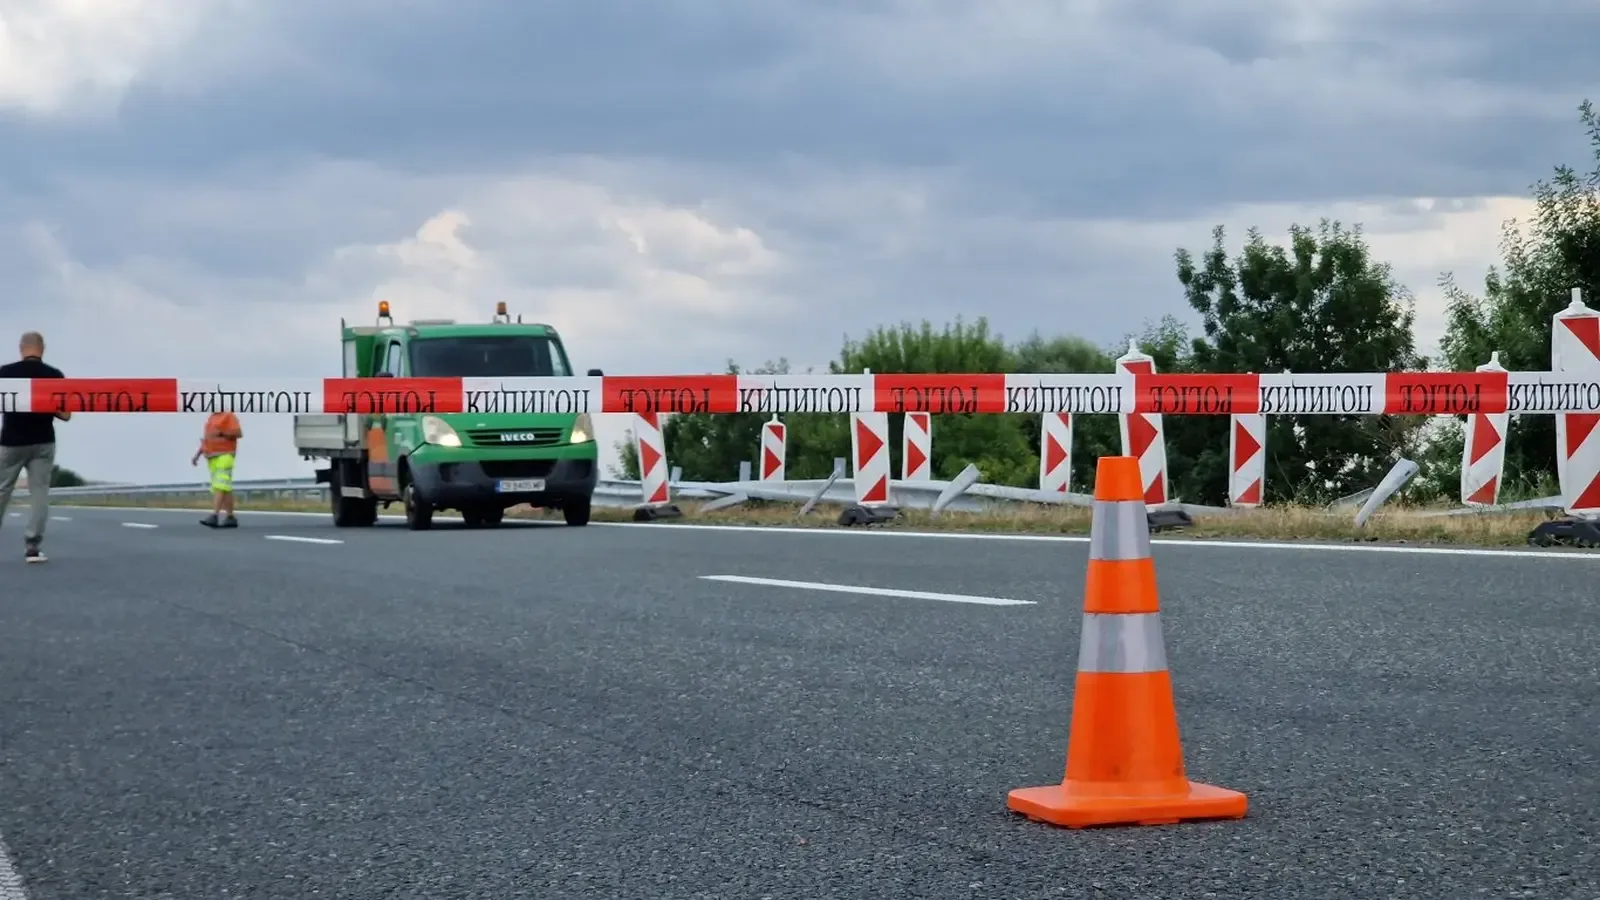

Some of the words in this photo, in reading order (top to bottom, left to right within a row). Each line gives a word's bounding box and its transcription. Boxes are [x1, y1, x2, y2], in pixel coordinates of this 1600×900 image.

[52, 391, 149, 413] POLICE
[181, 383, 311, 413] ПОЛИЦИЯ
[342, 390, 437, 413] POLICE
[467, 381, 589, 413] ПОЛИЦИЯ
[620, 387, 710, 413] POLICE
[740, 380, 861, 413] ПОЛИЦИЯ
[890, 386, 979, 413] POLICE
[1006, 379, 1121, 413] ПОЛИЦИЯ
[1149, 385, 1233, 413] POLICE
[1260, 378, 1372, 413] ПОЛИЦИЯ
[1398, 384, 1481, 413] POLICE
[1508, 376, 1600, 411] ОЛИЦИЯ
[500, 432, 535, 441] IVECO
